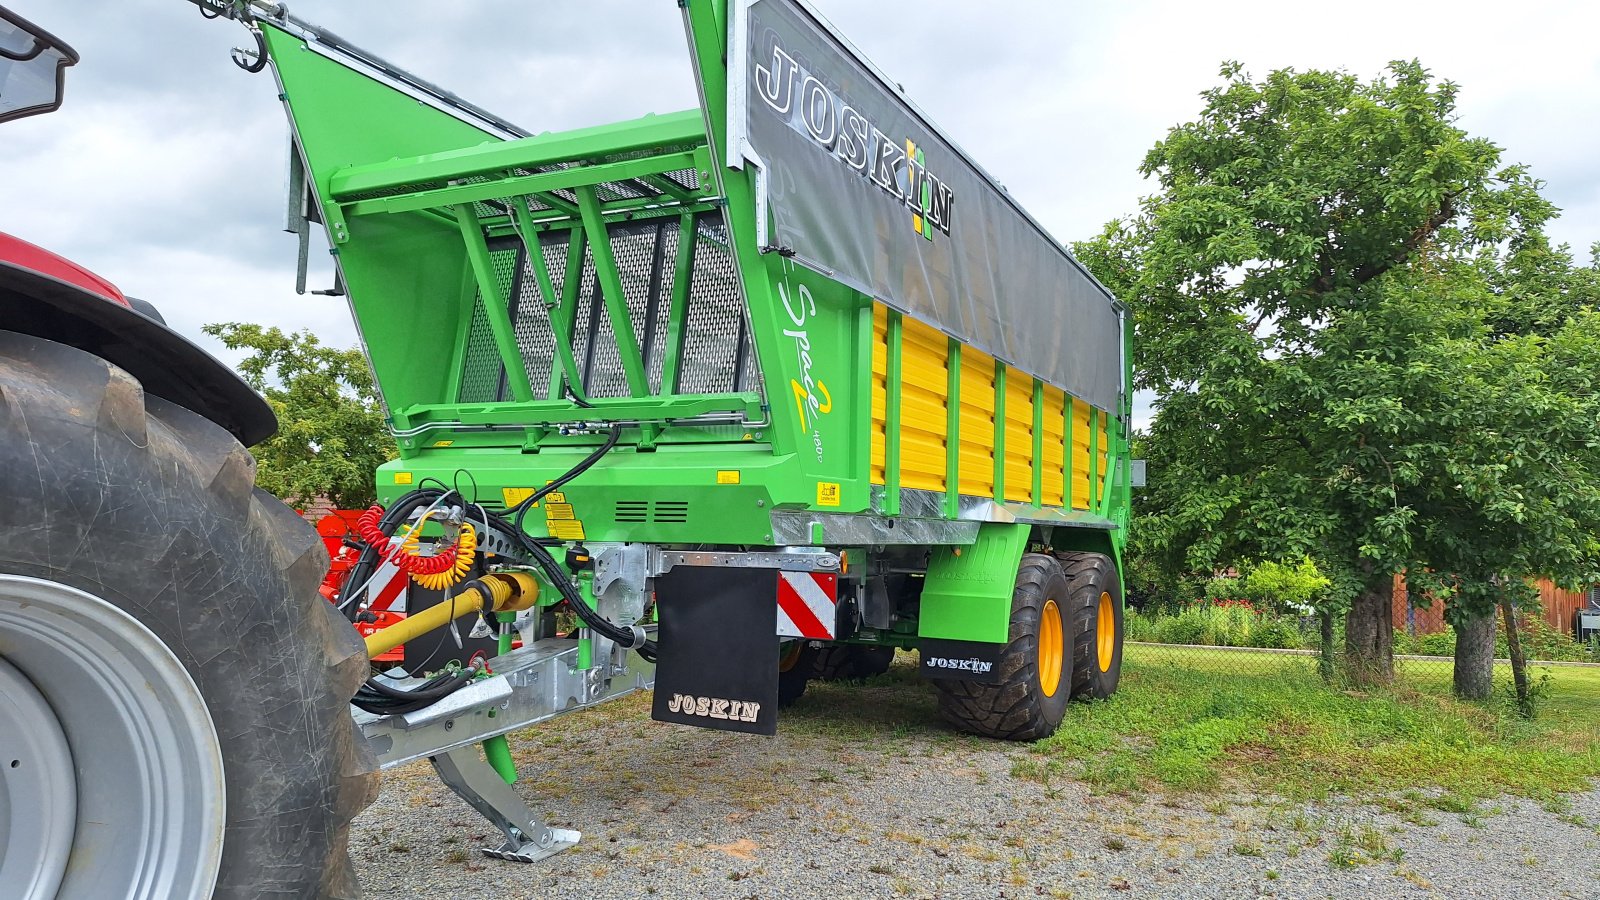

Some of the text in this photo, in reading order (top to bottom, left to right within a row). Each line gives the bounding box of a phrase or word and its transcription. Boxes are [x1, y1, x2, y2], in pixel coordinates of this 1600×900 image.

[755, 44, 954, 236] JOSKIN
[926, 656, 993, 673] JOSKIN
[668, 693, 761, 723] JOSKIN
